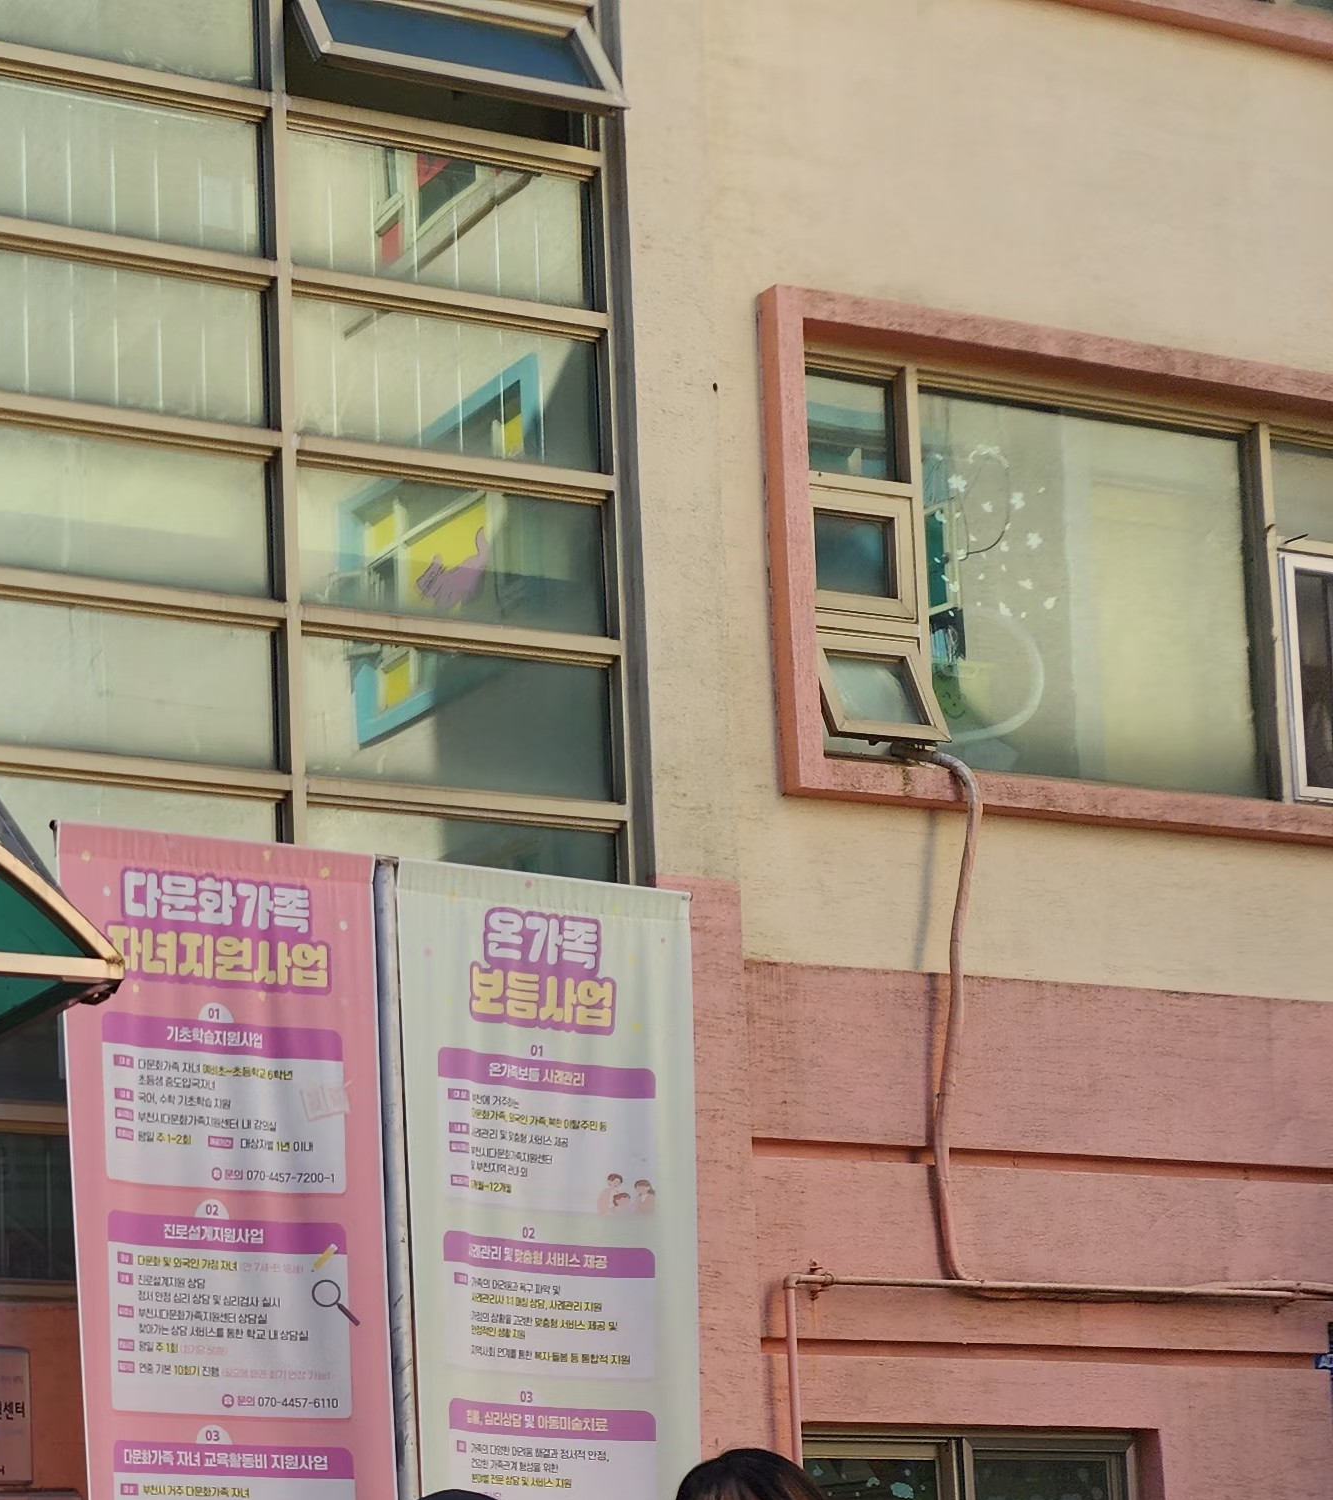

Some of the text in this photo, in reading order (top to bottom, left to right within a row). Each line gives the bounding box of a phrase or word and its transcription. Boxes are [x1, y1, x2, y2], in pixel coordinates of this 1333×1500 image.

[124, 870, 310, 934] 다문화가족
[487, 911, 598, 970] 온가족
[107, 924, 328, 988] 자녀지원사업
[471, 965, 613, 1027] 보듬사업
[208, 1008, 220, 1020] 01
[167, 1025, 263, 1048] 기초학습지원사업
[531, 1045, 543, 1056] 01
[206, 1204, 219, 1216] 02
[164, 1223, 264, 1244] 진로설계지원사업
[522, 1227, 535, 1239] 02
[137, 1255, 161, 1267] 다문화
[163, 1256, 172, 1267] 및
[173, 1257, 200, 1269] 외국인
[202, 1259, 219, 1270] 가정
[221, 1259, 237, 1271] 자녀
[546, 1251, 581, 1268] 서비스
[583, 1254, 608, 1269] 제공
[187, 1277, 206, 1289] 상담
[611, 1354, 630, 1365] 지원
[258, 1396, 339, 1409] 070-4457-6110
[520, 1391, 533, 1403] 03
[485, 1410, 608, 1432] 심리상담 및 아동미술치료
[205, 1430, 220, 1442] 03
[124, 1448, 329, 1471] 다문화가족 자녀 교육활동비 지원사업
[142, 1484, 250, 1498] 부천시 거주 다문화가족 자녀
